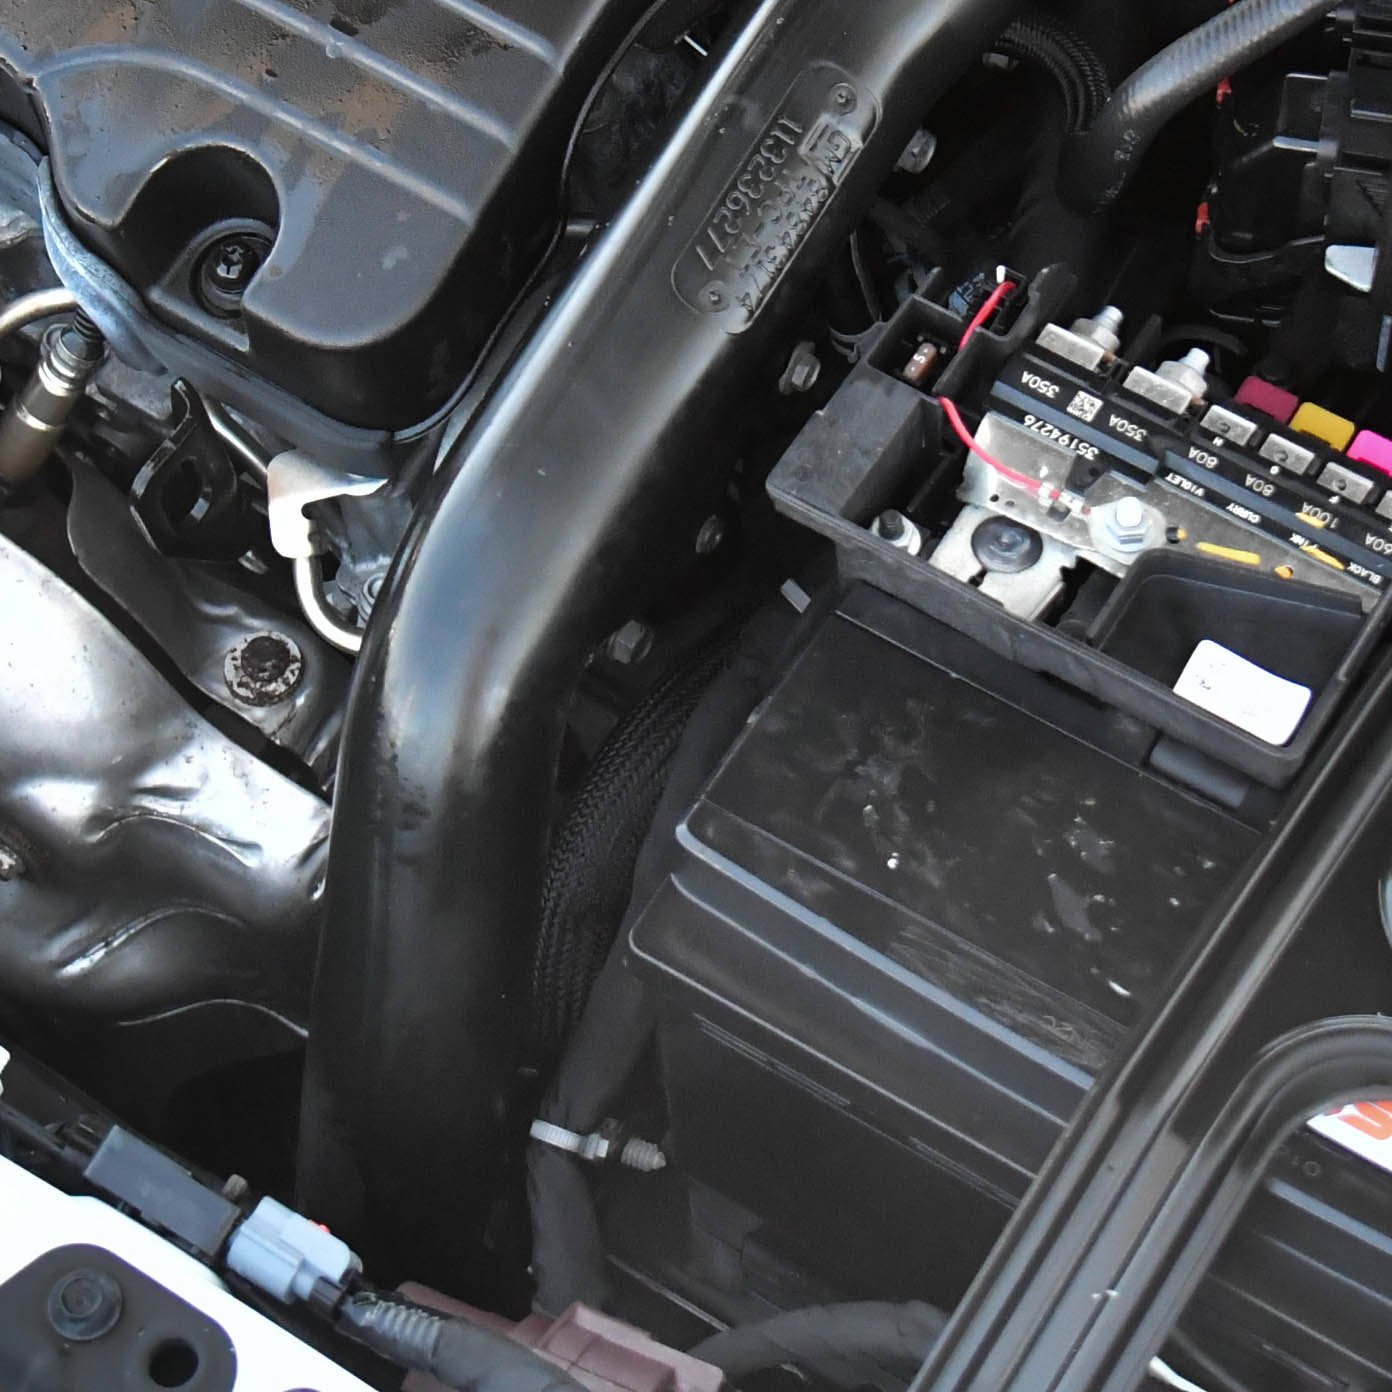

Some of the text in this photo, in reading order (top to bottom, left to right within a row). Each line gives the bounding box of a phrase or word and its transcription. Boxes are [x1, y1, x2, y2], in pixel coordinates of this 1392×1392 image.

[696, 117, 803, 271] 113236277
[1021, 371, 1060, 398] 350A
[1023, 415, 1099, 460] 35194276
[1110, 414, 1148, 441] 350A
[1188, 447, 1217, 470] 80A
[1166, 472, 1204, 497] VIOLET
[1245, 475, 1274, 497] 80A
[1227, 503, 1261, 524] CURRY
[1302, 502, 1339, 529] 100A
[1347, 562, 1382, 584] BLACK
